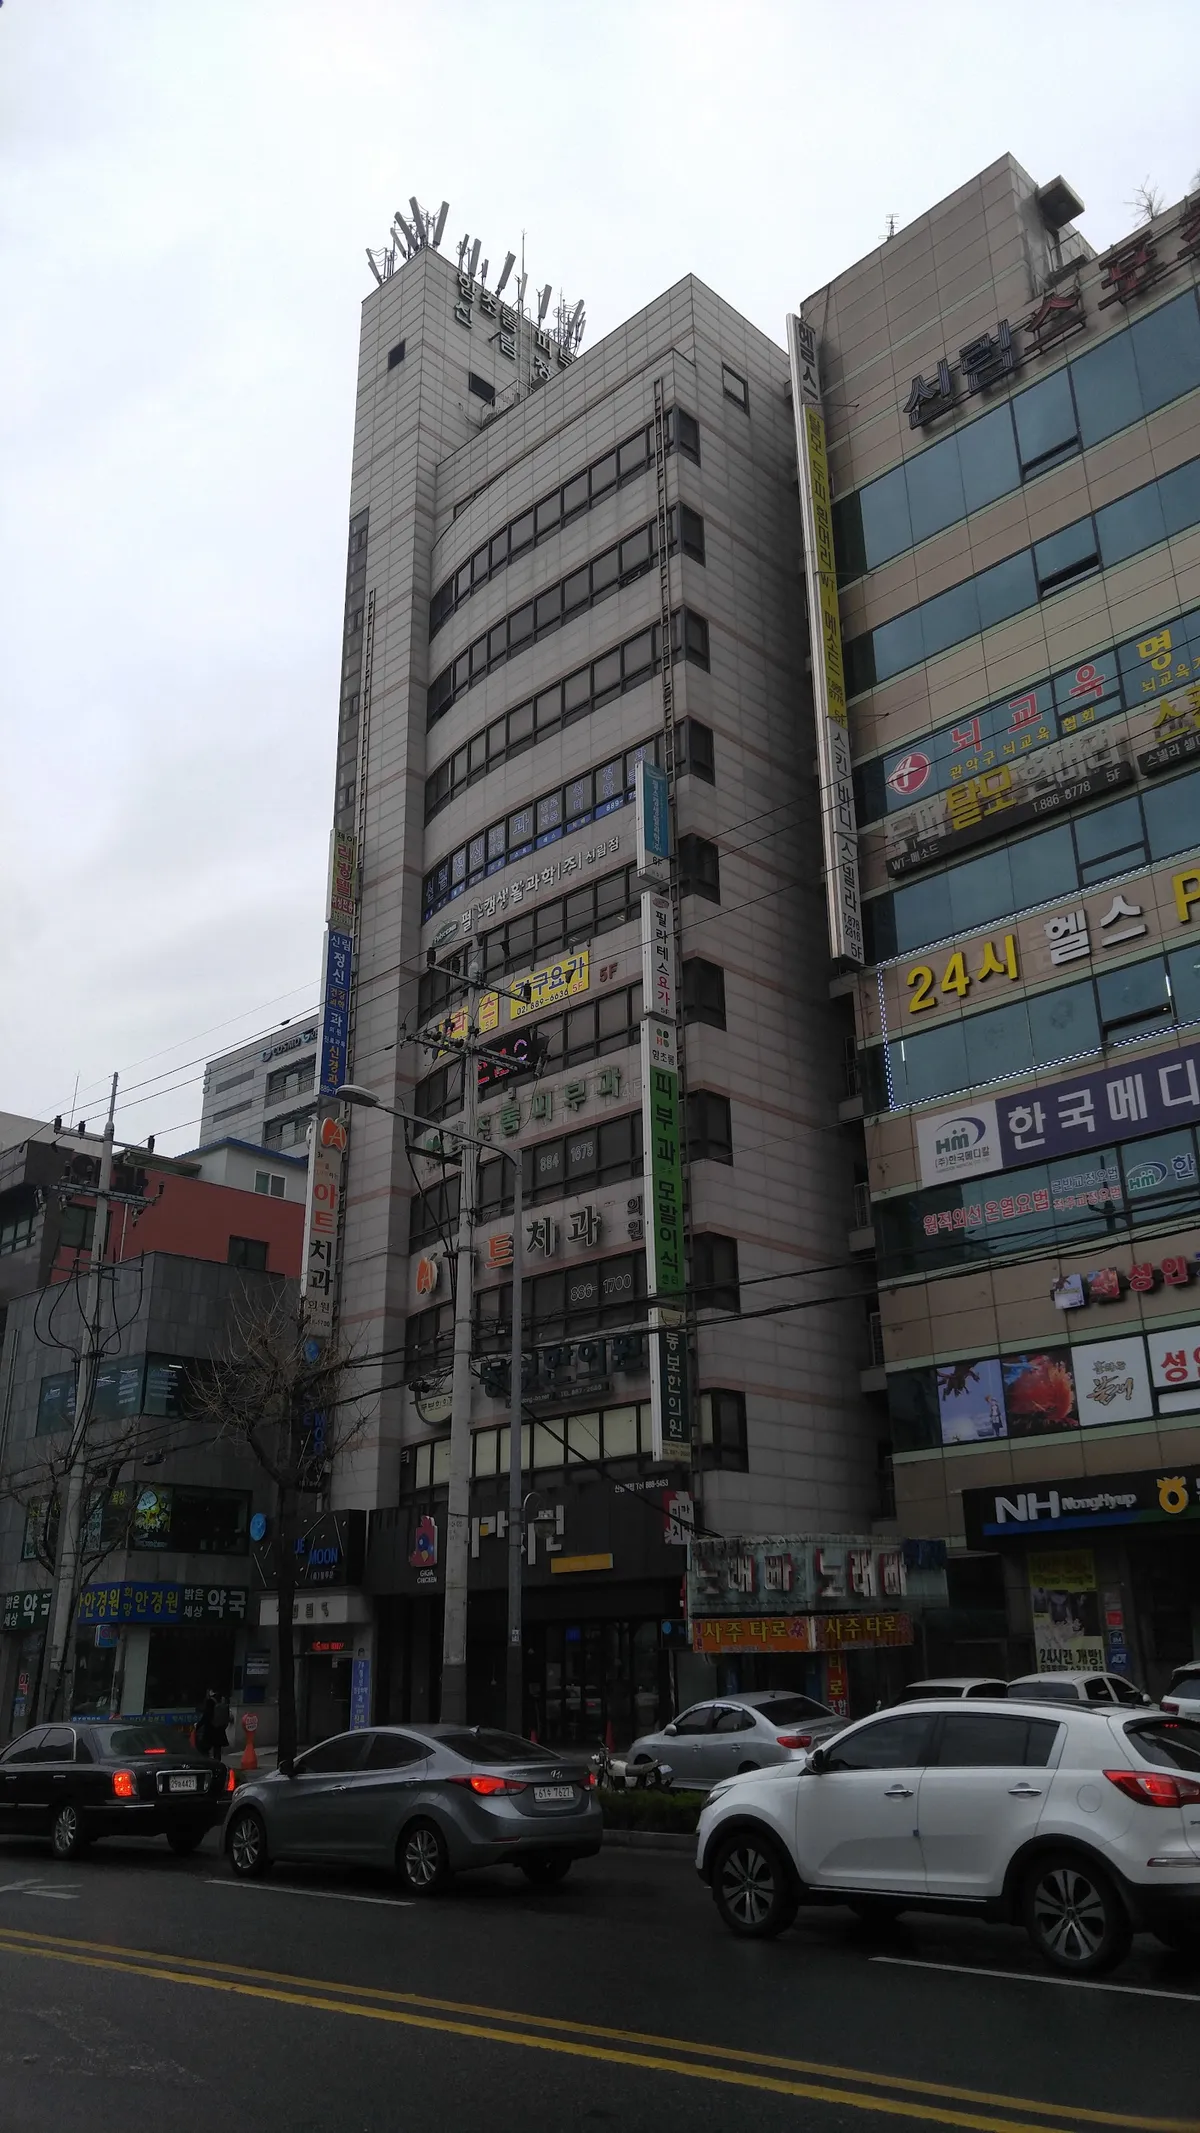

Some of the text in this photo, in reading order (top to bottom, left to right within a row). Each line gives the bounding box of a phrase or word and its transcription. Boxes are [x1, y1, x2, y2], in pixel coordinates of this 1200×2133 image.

[798, 320, 818, 400] 헬스
[903, 318, 1015, 430] 신림
[949, 750, 996, 780] 관악구
[1002, 726, 1050, 756] 뇌교육
[834, 732, 852, 831] 스킨 바디
[946, 766, 1017, 830] 탈모
[585, 835, 619, 863] 신림점
[331, 935, 350, 952] 신림
[655, 910, 669, 976] 필라테스
[851, 942, 862, 959] 5F
[905, 934, 1019, 1014] 24시
[1044, 894, 1147, 966] 헬스
[333, 951, 346, 985] 정신
[599, 962, 618, 982] 5F
[572, 981, 584, 993] 5F
[657, 976, 670, 1006] 요가
[331, 1012, 343, 1028] 과
[327, 1045, 340, 1086] 신경과
[656, 1072, 676, 1166] 피부과
[658, 1180, 678, 1273] 모발이식
[923, 1204, 982, 1236] 원적외선
[985, 1188, 1050, 1222] 온열요법
[309, 1183, 338, 1295] 아트치과
[603, 1273, 632, 1294] 1700
[1127, 1255, 1189, 1292] 성인
[307, 1300, 330, 1314] 의원
[1161, 1347, 1200, 1382] 성
[994, 1490, 1137, 1523] NH NongHyup
[309, 1547, 338, 1565] MOON
[417, 1576, 438, 1584] CHICKEN
[135, 1590, 179, 1613] 안경원
[183, 1588, 204, 1601] 밝은
[207, 1588, 246, 1619] 약국
[183, 1605, 204, 1618] 세상
[704, 1621, 743, 1644] 사주
[749, 1620, 788, 1642] 타로
[825, 1618, 862, 1640] 사주
[865, 1615, 896, 1636] 타로
[1040, 1648, 1103, 1665] 24시간 개방!
[18, 1672, 30, 1695] 약
